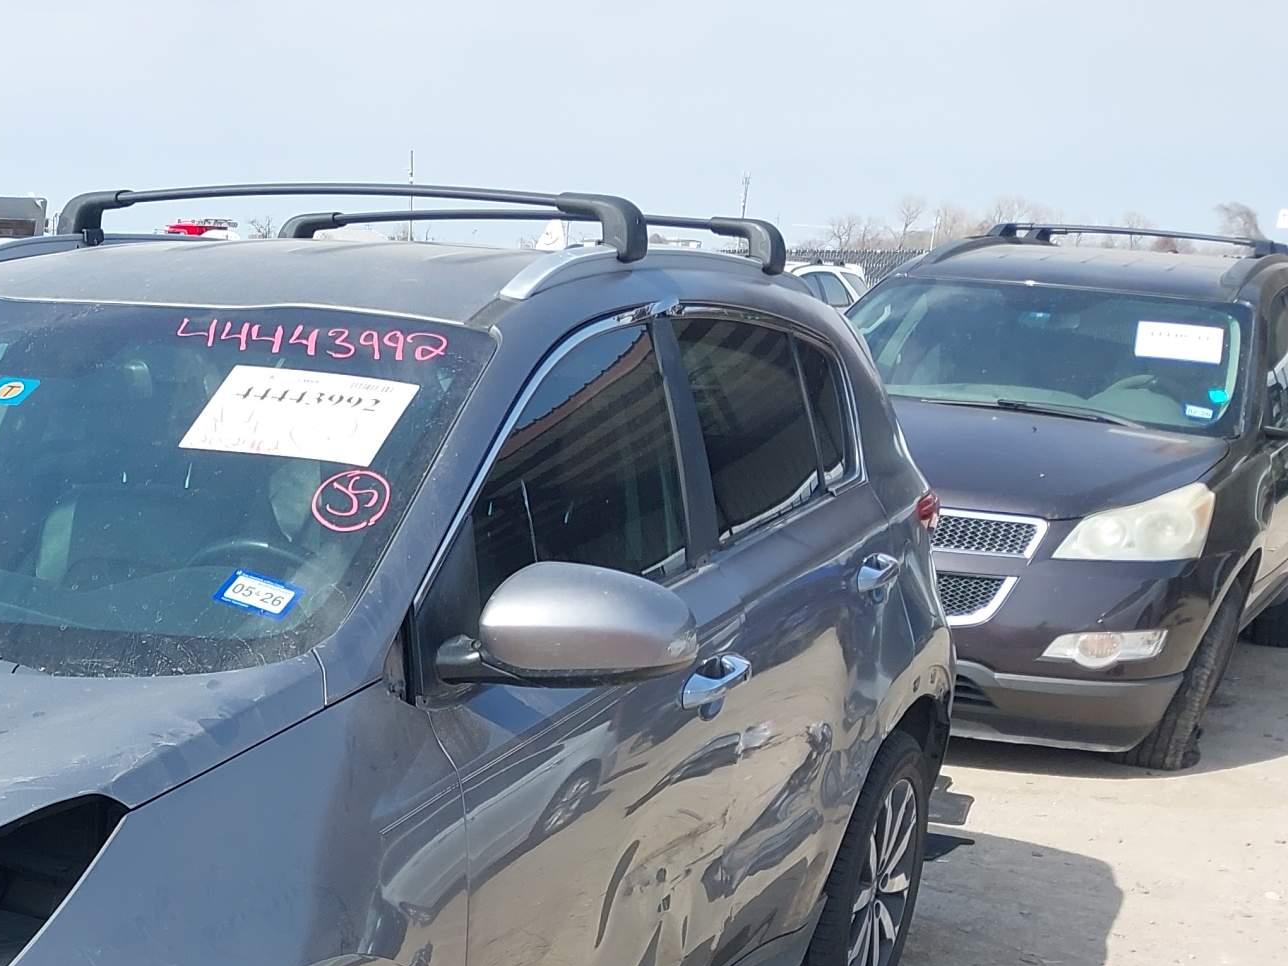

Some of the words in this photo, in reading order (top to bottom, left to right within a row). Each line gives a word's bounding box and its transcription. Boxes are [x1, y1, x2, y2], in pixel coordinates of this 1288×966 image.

[177, 317, 448, 361] 44443992
[231, 583, 256, 598] 05
[260, 592, 285, 607] 26
